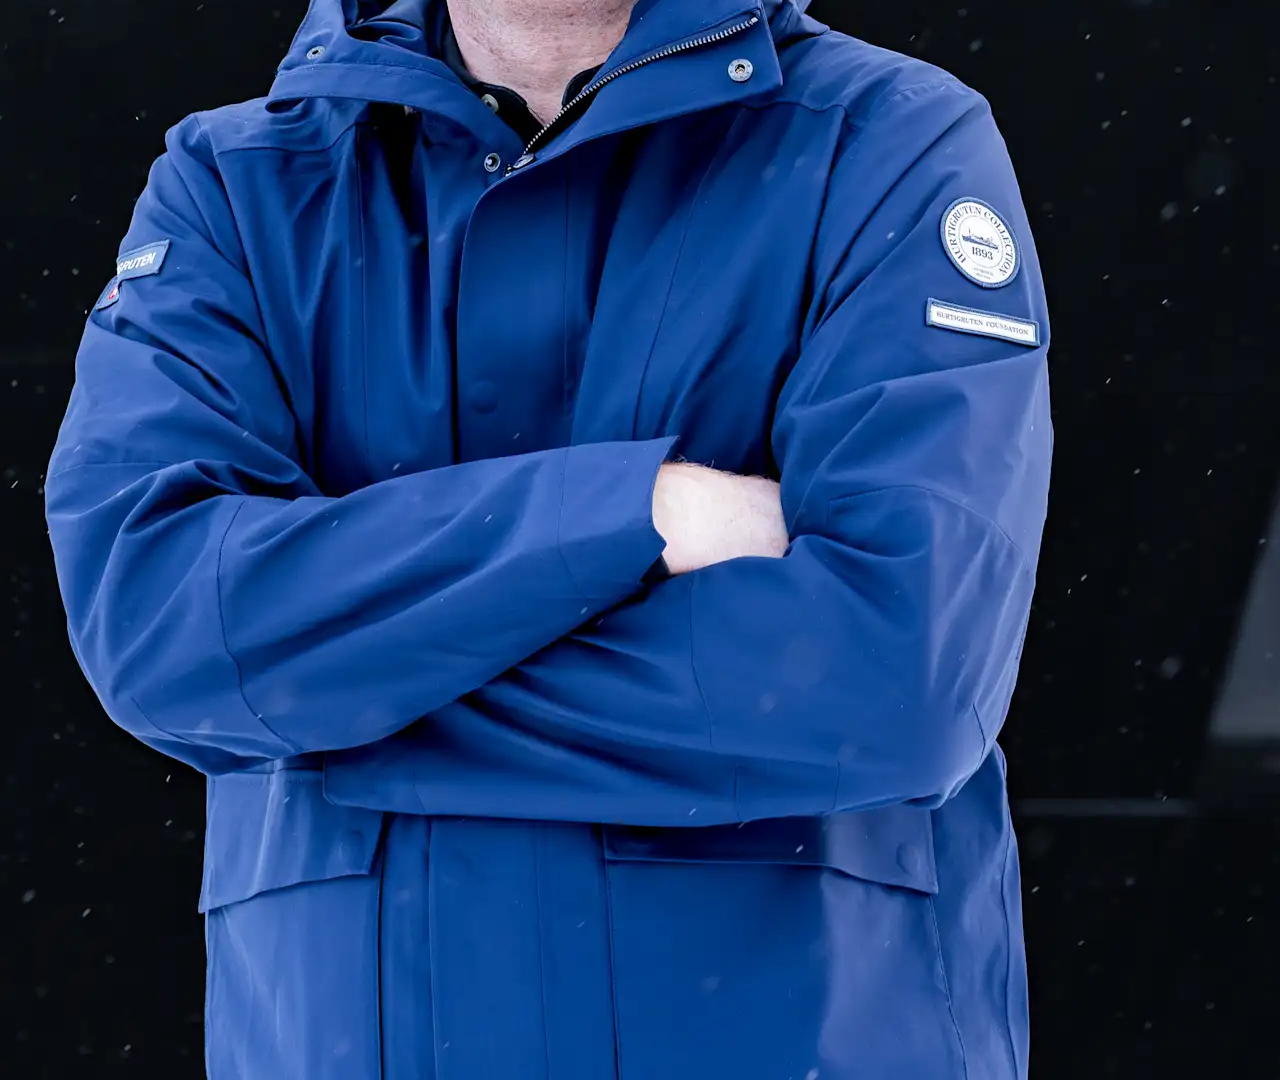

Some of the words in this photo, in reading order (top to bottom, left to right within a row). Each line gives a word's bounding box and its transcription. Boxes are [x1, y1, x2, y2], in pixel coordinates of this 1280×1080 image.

[947, 205, 982, 263] HURTIGRUTEN
[984, 211, 1013, 276] COLLECTION
[971, 246, 994, 261] 1893
[936, 311, 983, 326] HURTIGRUTEN
[985, 320, 1029, 336] FOUNDATION
